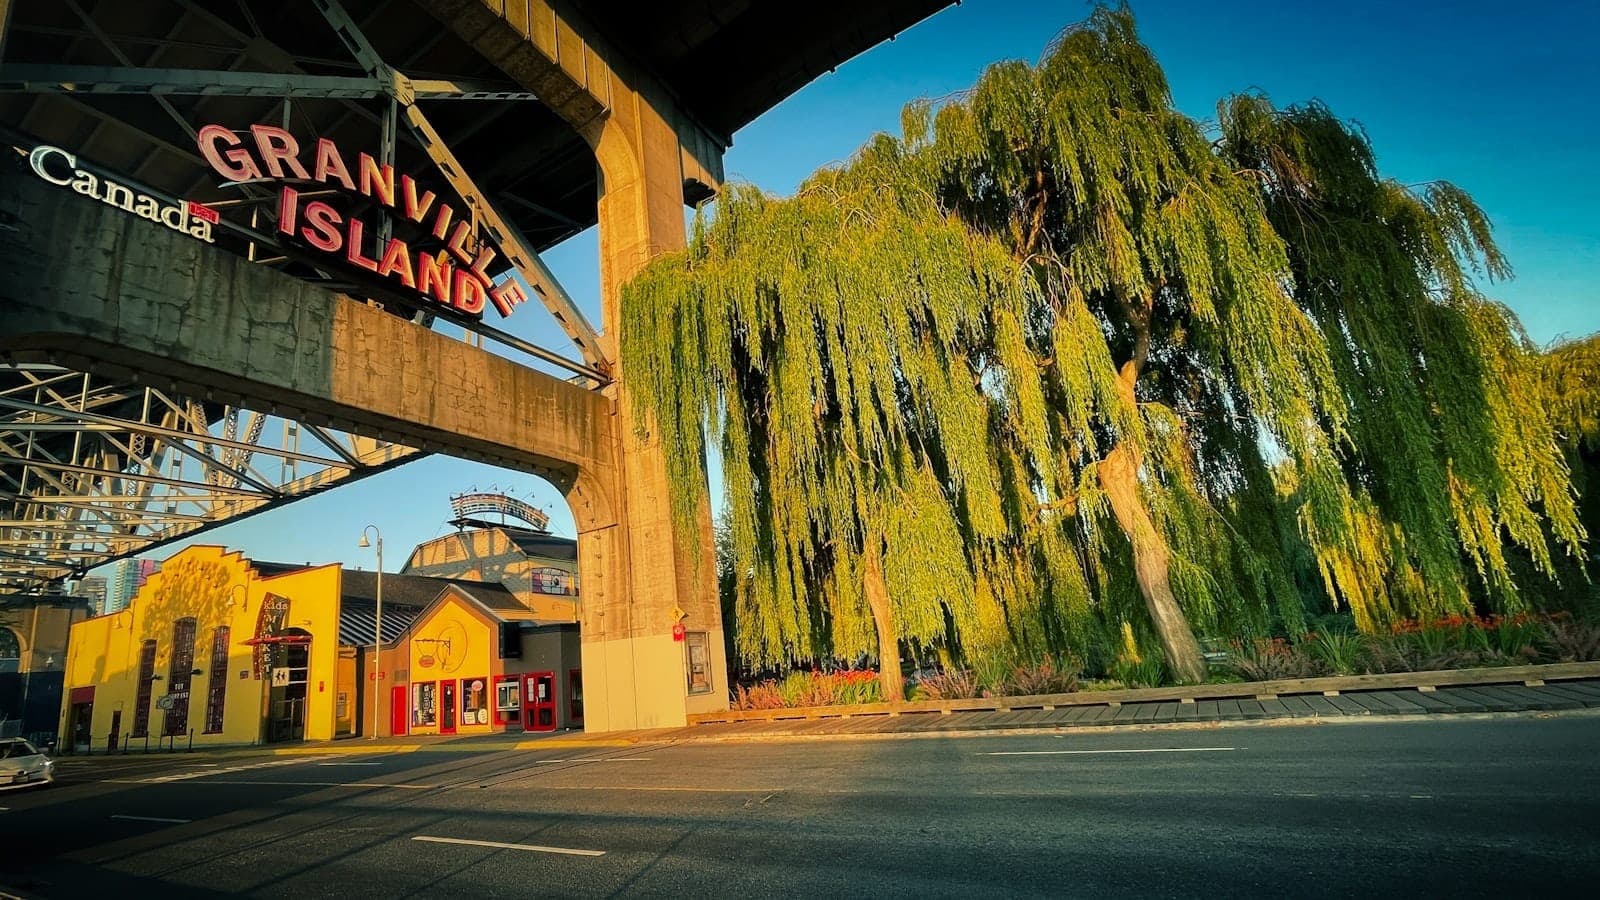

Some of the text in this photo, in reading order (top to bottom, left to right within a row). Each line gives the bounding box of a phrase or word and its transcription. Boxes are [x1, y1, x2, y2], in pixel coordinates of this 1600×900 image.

[29, 145, 216, 243] Canada
[197, 124, 528, 318] GRANVILLE
[279, 186, 486, 314] ISLAND
